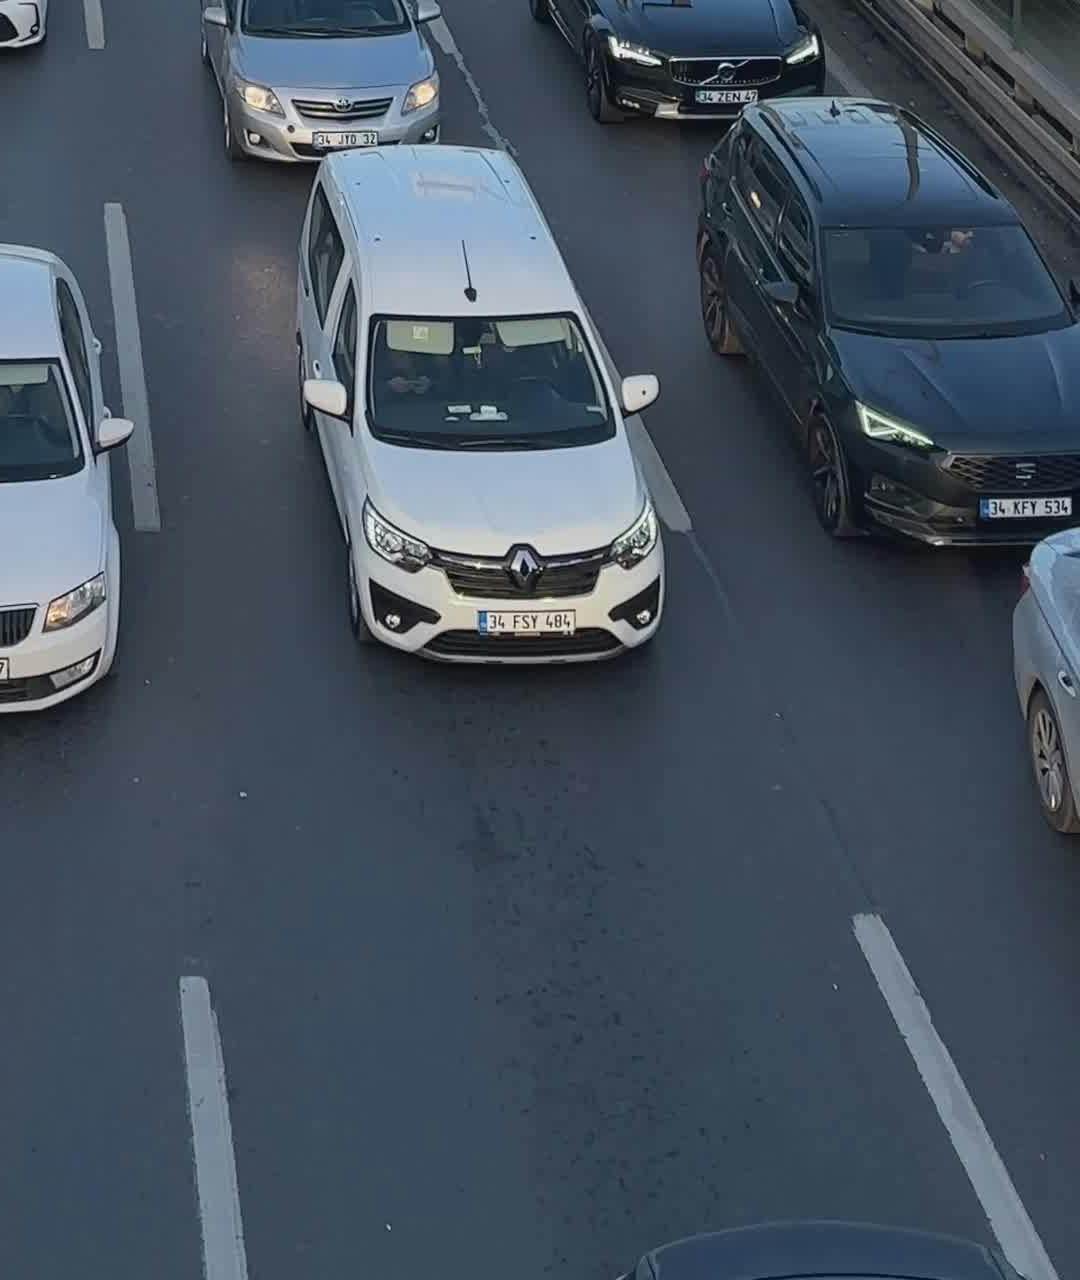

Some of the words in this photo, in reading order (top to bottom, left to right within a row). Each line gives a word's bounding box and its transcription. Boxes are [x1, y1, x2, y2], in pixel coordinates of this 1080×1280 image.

[700, 92, 713, 102] 34
[718, 92, 741, 102] ZEN
[318, 134, 331, 145] 34
[363, 134, 376, 145] 32
[990, 501, 1006, 516] 34
[1013, 500, 1037, 515] KFY
[1045, 500, 1068, 514] 534
[489, 614, 505, 629] 34
[513, 614, 538, 629] FSY
[545, 614, 571, 629] 484
